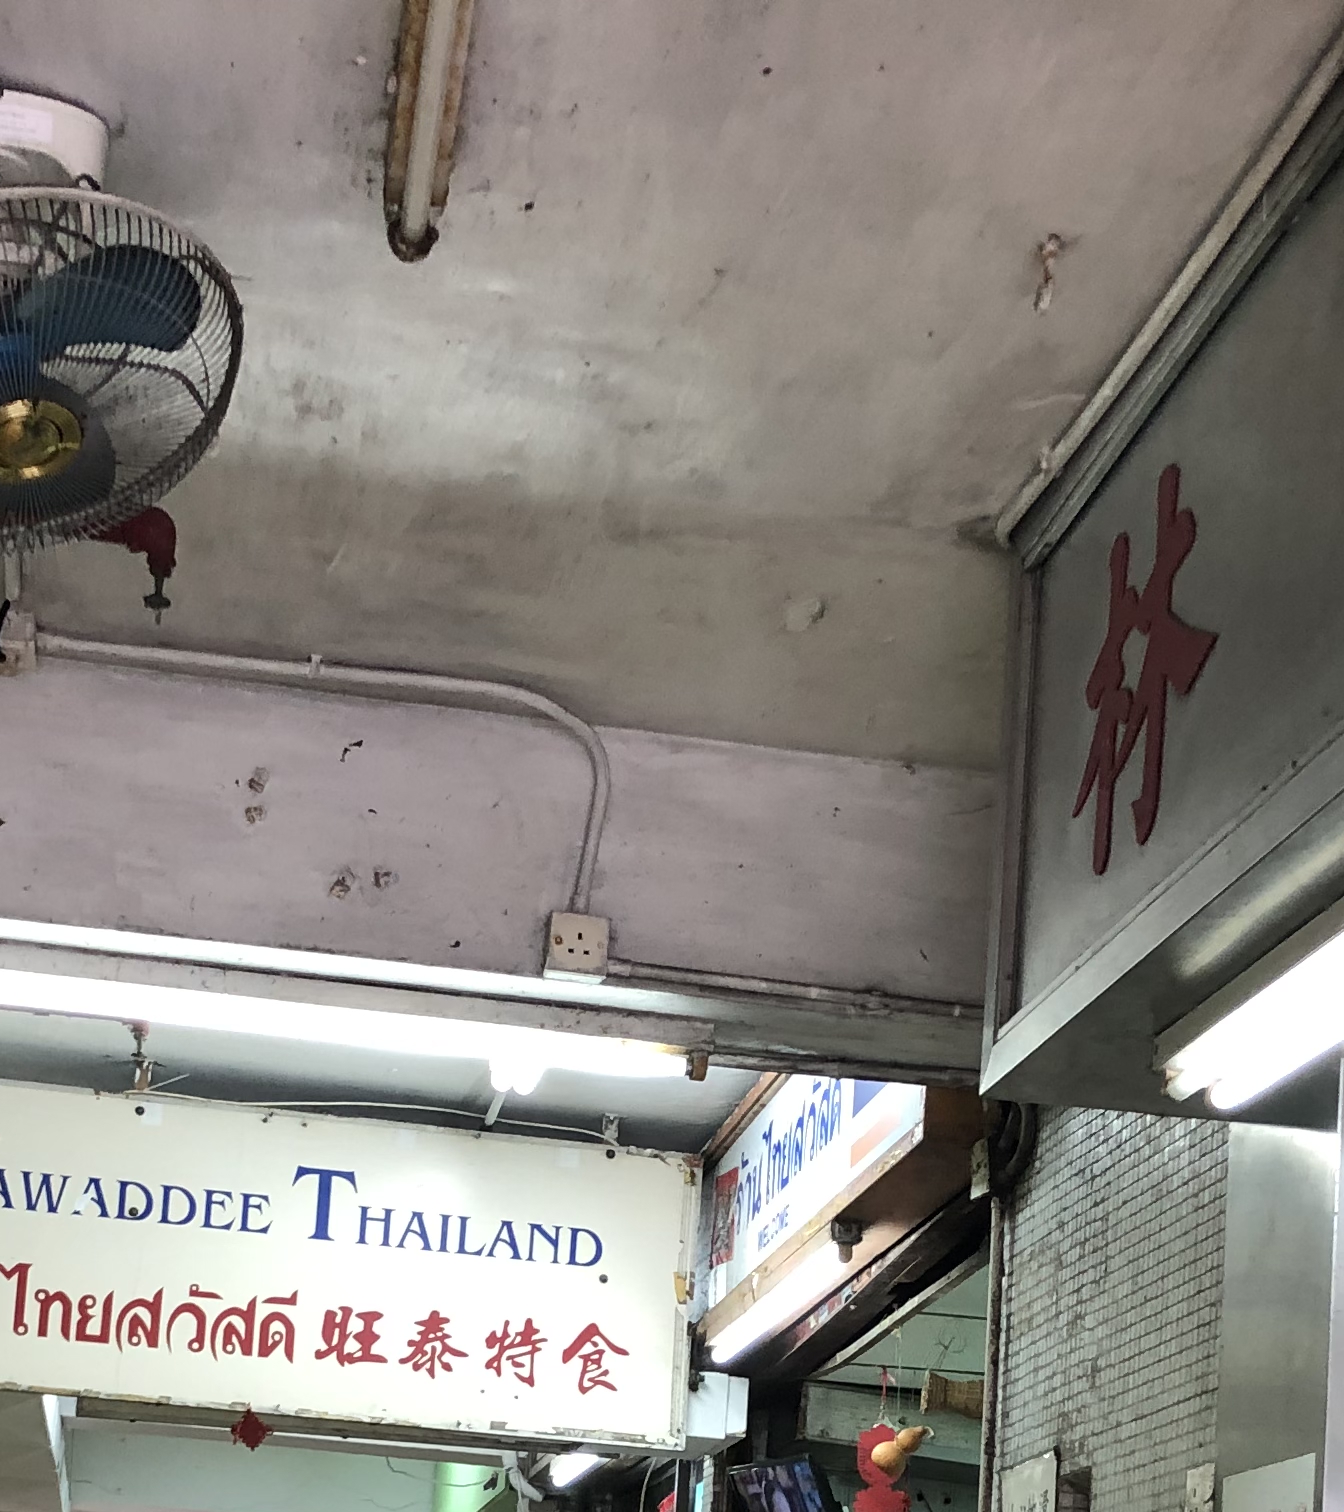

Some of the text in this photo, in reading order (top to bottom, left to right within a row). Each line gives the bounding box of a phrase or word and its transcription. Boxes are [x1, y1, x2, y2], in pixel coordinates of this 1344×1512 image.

[732, 1077, 843, 1235] ร้านไทยสวัสด
[293, 1166, 605, 1268] THAILAND
[315, 1306, 632, 1396] 旺泰特食
